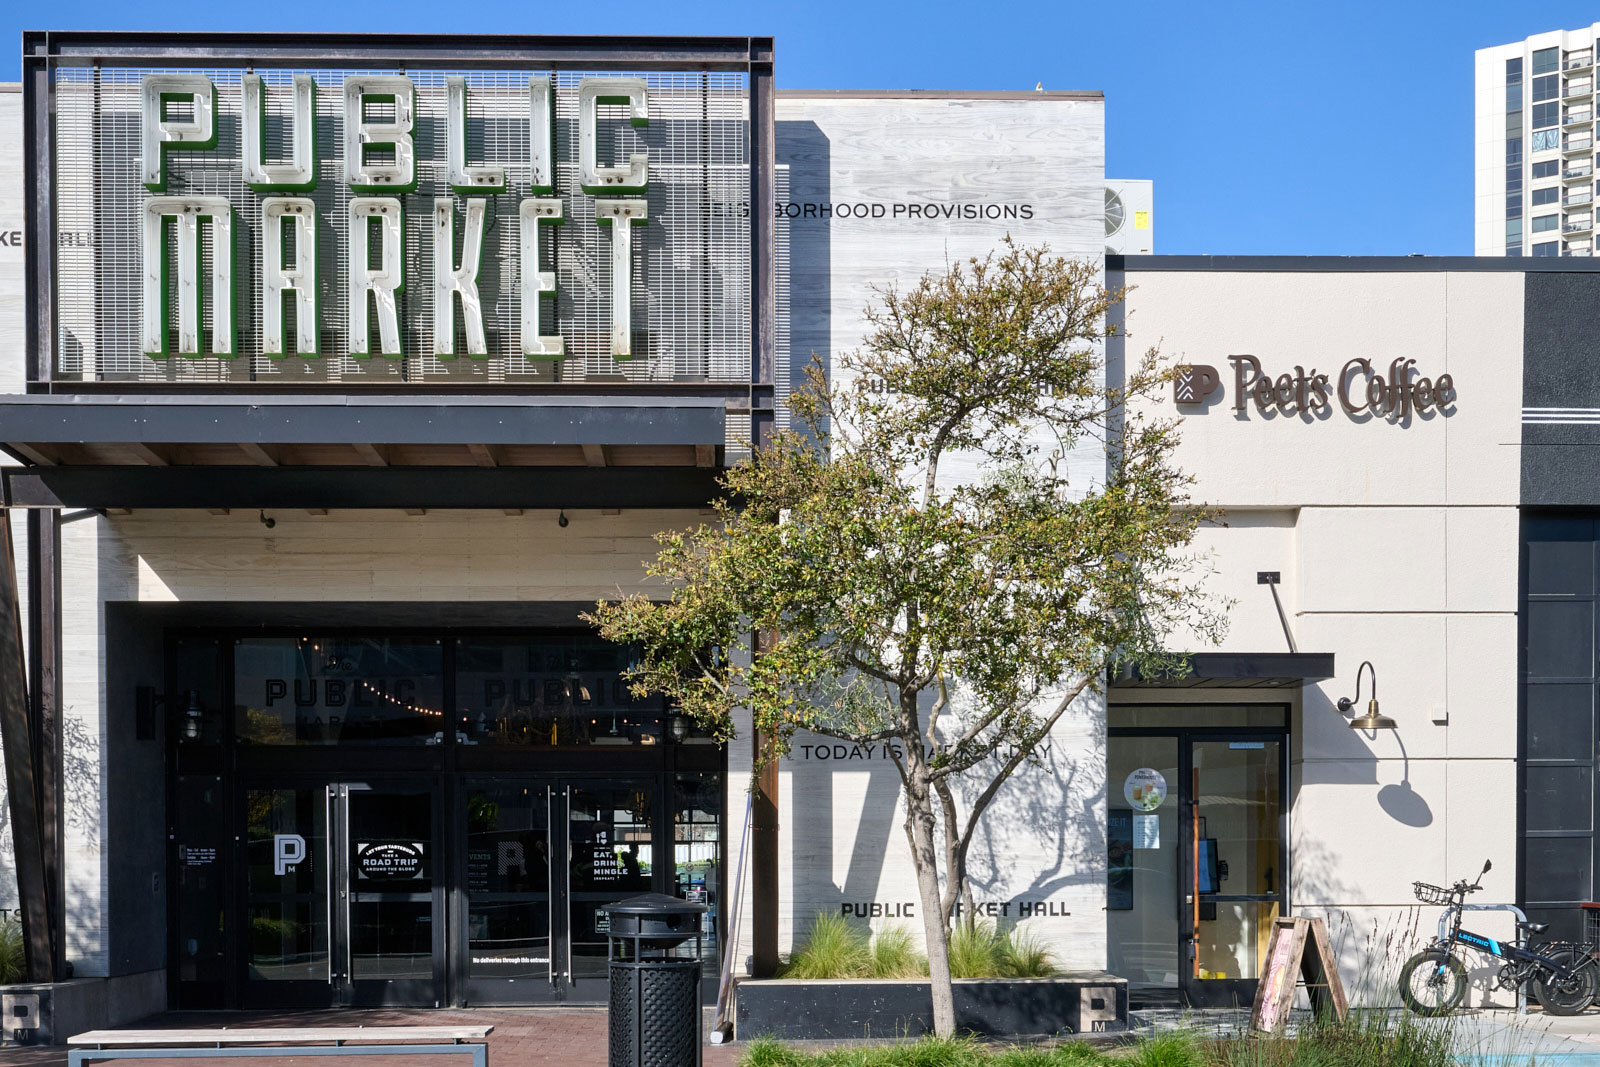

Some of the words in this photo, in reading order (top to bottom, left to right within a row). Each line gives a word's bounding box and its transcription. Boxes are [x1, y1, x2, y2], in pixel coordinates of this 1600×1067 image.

[142, 74, 648, 195] PUBLIC
[892, 203, 1035, 220] PROVISIONS
[142, 196, 648, 361] MARKET
[1227, 354, 1329, 412] Peet's
[1337, 356, 1454, 418] Coffee
[266, 679, 415, 707] PUBLIC
[800, 744, 876, 760] TODAY
[883, 744, 903, 760] IS
[842, 902, 915, 919] PUBLIC
[1019, 901, 1071, 917] HALL
[1458, 932, 1490, 947] LECTRIC
